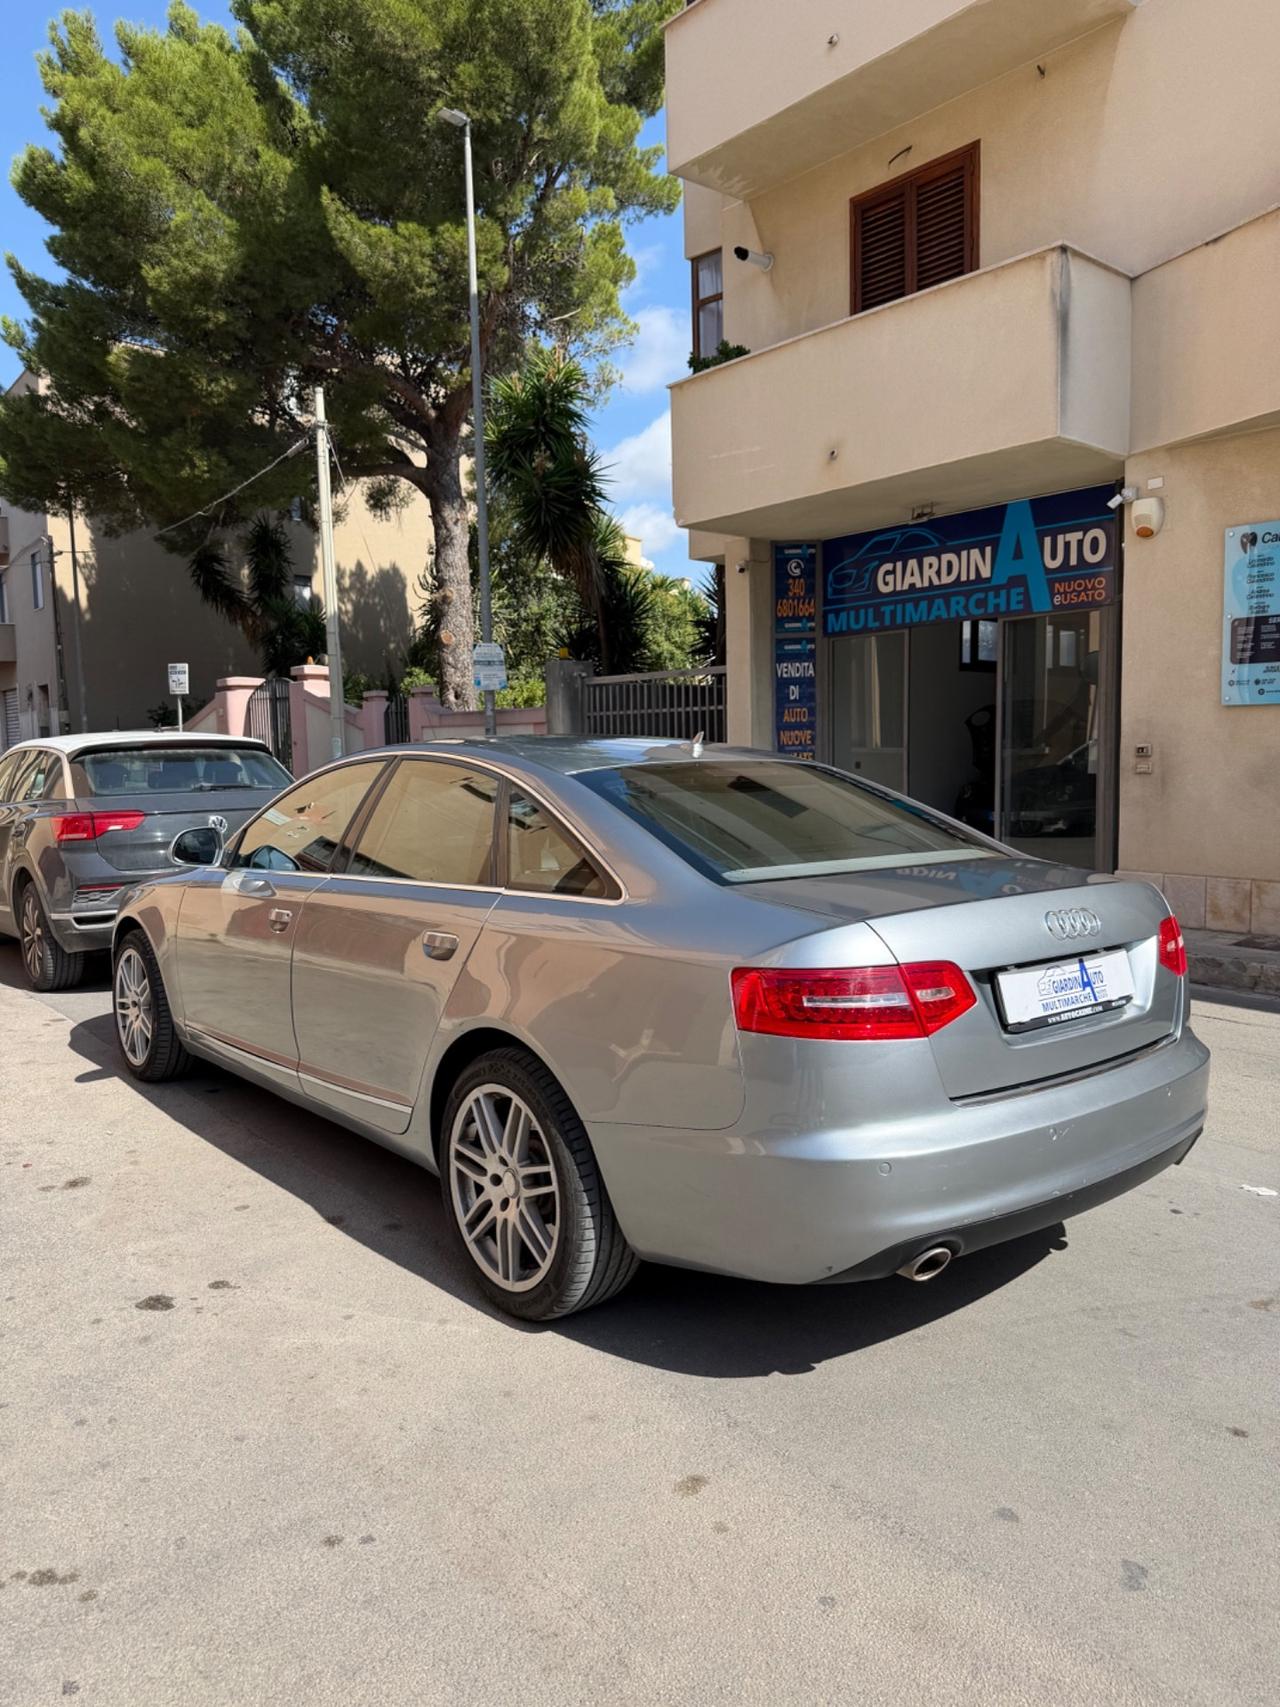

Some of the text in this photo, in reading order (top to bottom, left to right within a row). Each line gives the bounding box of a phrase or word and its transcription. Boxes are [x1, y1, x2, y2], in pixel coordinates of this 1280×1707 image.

[788, 578, 805, 596] 340
[1054, 577, 1106, 593] NUOVO
[777, 599, 815, 617] 6801664
[827, 587, 1024, 633] MULTIMARCHE
[776, 662, 815, 678] VENDITA
[789, 685, 799, 700] DI
[783, 708, 808, 722] AUTO
[780, 730, 812, 745] NUOVE
[1041, 992, 1092, 1013] MULTIMARCHE
